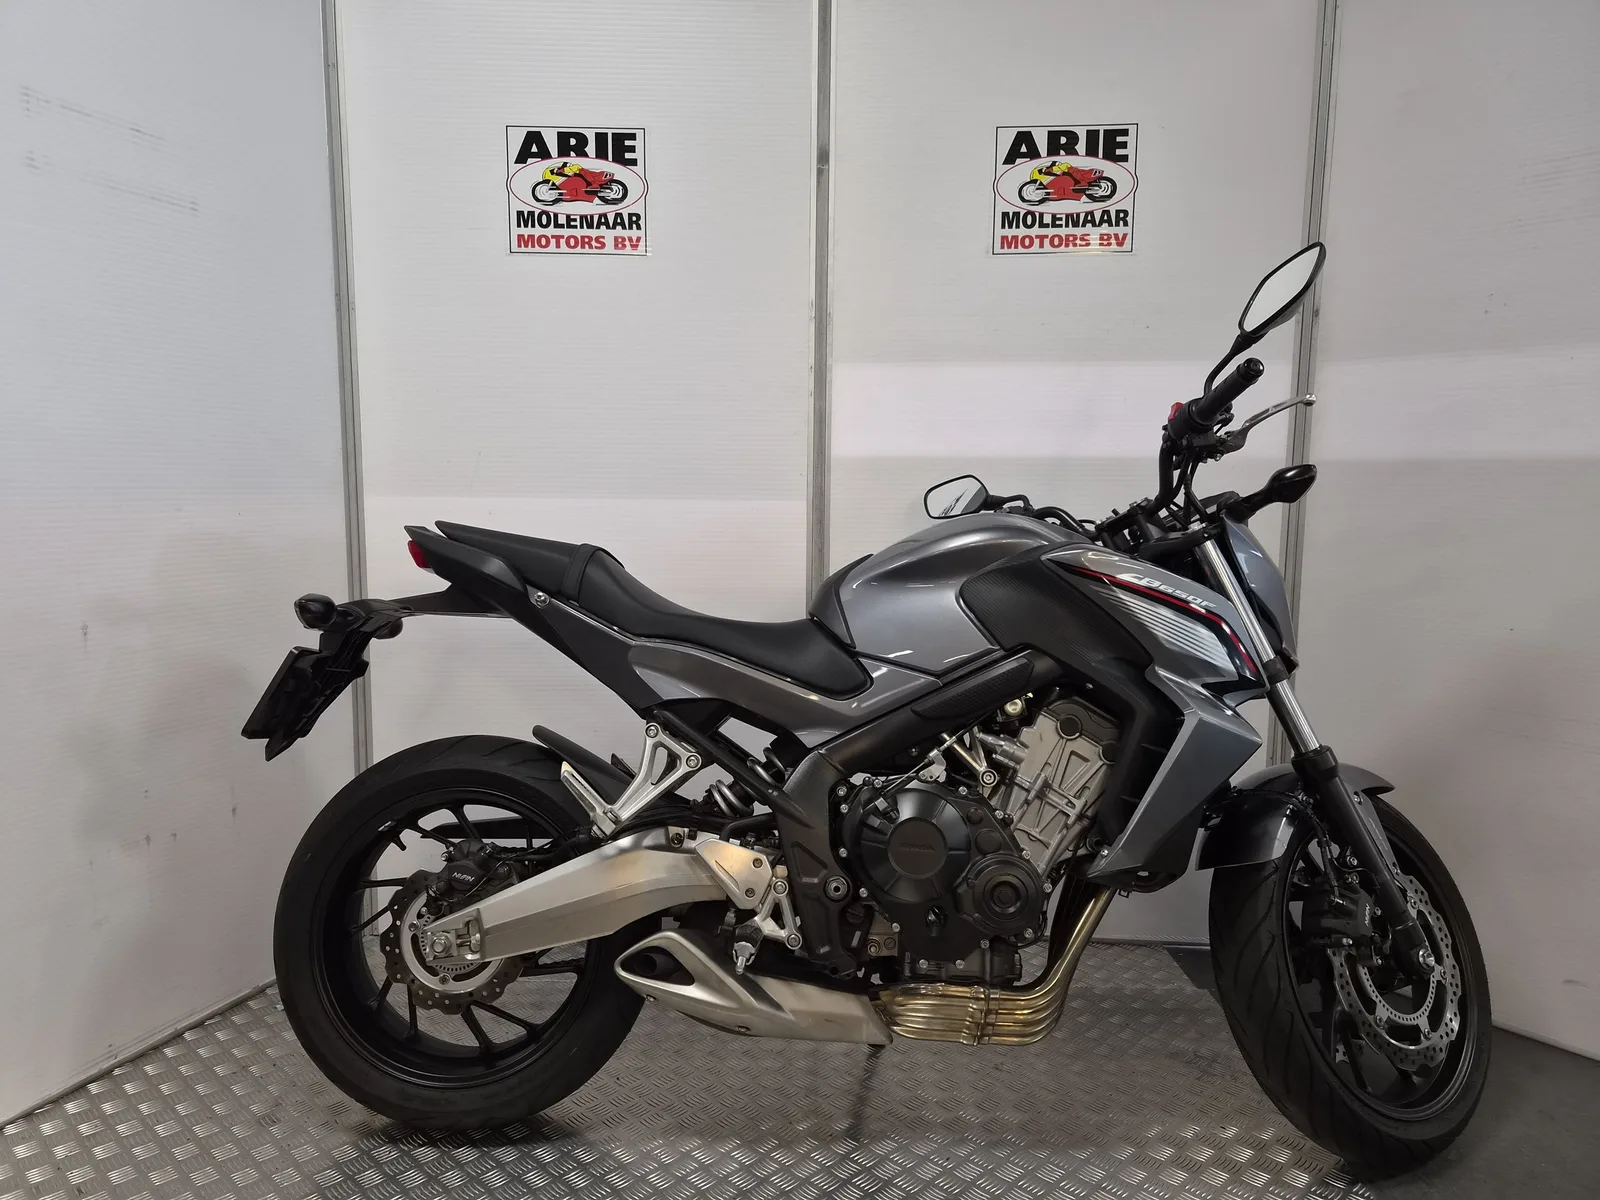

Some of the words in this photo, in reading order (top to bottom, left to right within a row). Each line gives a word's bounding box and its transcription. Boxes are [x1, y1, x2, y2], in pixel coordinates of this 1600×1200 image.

[514, 131, 638, 167] ARIE
[1002, 129, 1129, 165] ARIE
[516, 210, 642, 230] MOLENAAR
[1000, 209, 1129, 229] MOLENAAR
[516, 234, 607, 250] MOTORS
[613, 236, 642, 250] BV
[1000, 233, 1091, 250] MOTORS
[1098, 233, 1128, 248] BV
